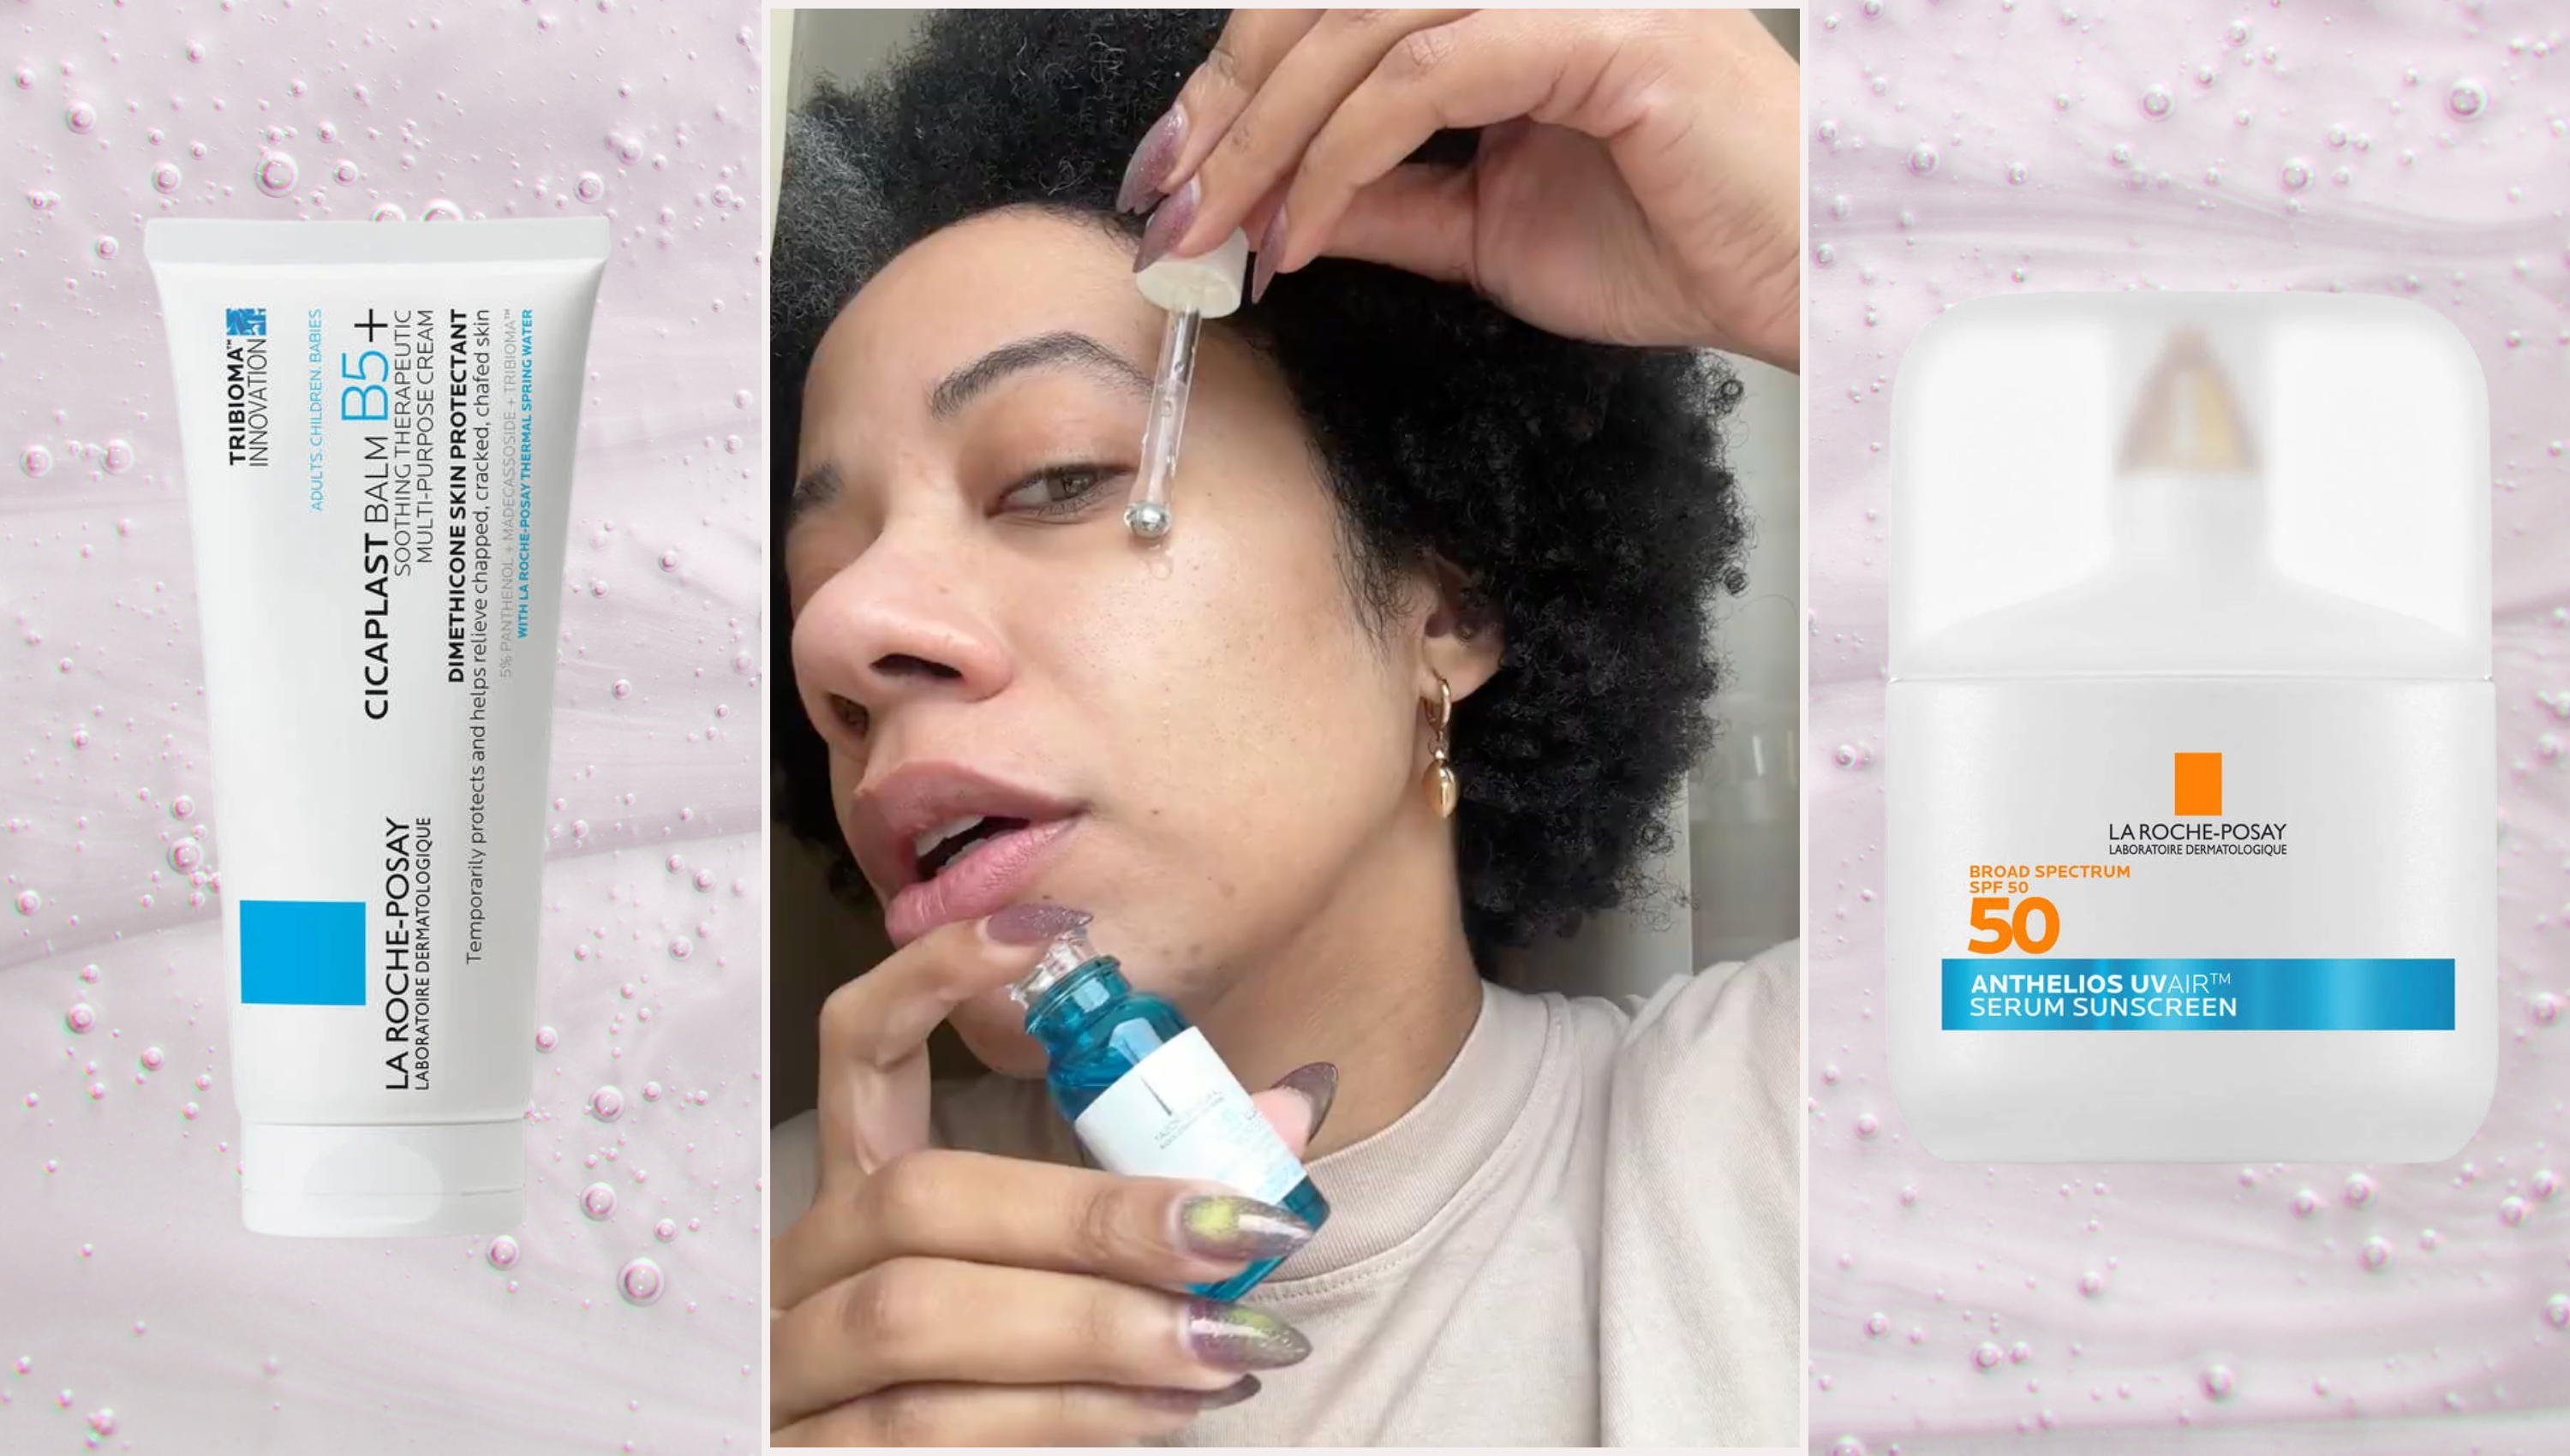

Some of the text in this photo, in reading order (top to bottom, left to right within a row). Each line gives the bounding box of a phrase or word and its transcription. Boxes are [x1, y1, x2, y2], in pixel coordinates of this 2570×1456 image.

[308, 309, 322, 362] BABIES
[247, 339, 268, 466] INNOVATION
[394, 311, 411, 576] SOOTHING THERAPEUTIC
[416, 311, 433, 563] MULTI-PURPOSE CREAM
[506, 399, 515, 409] +
[364, 437, 388, 522] BALM
[449, 309, 467, 682] DIMETHICONE SKIN PROTECTANT
[501, 412, 516, 541] MADECASSOSIDE
[517, 309, 533, 639] WITH LA ROCHE-POSAY THERMAL SPRING WATER
[505, 546, 513, 554] +
[364, 533, 388, 719] CICAPLAST
[466, 310, 492, 964] Temporarily protects and helps relieve chapped, cracked, chafed skin
[500, 559, 514, 652] PANTHENOL
[499, 655, 512, 677] 5%
[1970, 865, 2131, 878] BROAD SPECTRUM
[2110, 824, 2286, 840] LA ROCHE-POSAY
[2110, 844, 2286, 856] LABORATOIRE DERMATOLOGIQUE
[1968, 897, 2060, 954] 50
[1969, 880, 2029, 893] SPF 50
[386, 817, 409, 1089] LA ROCHE-POSAY
[415, 818, 433, 1089] LABORATOIRE DERMATOLOGIQUE
[1971, 975, 2123, 994] ANTHELIOS
[1970, 995, 2236, 1018] SERUM SUNSCREEN
